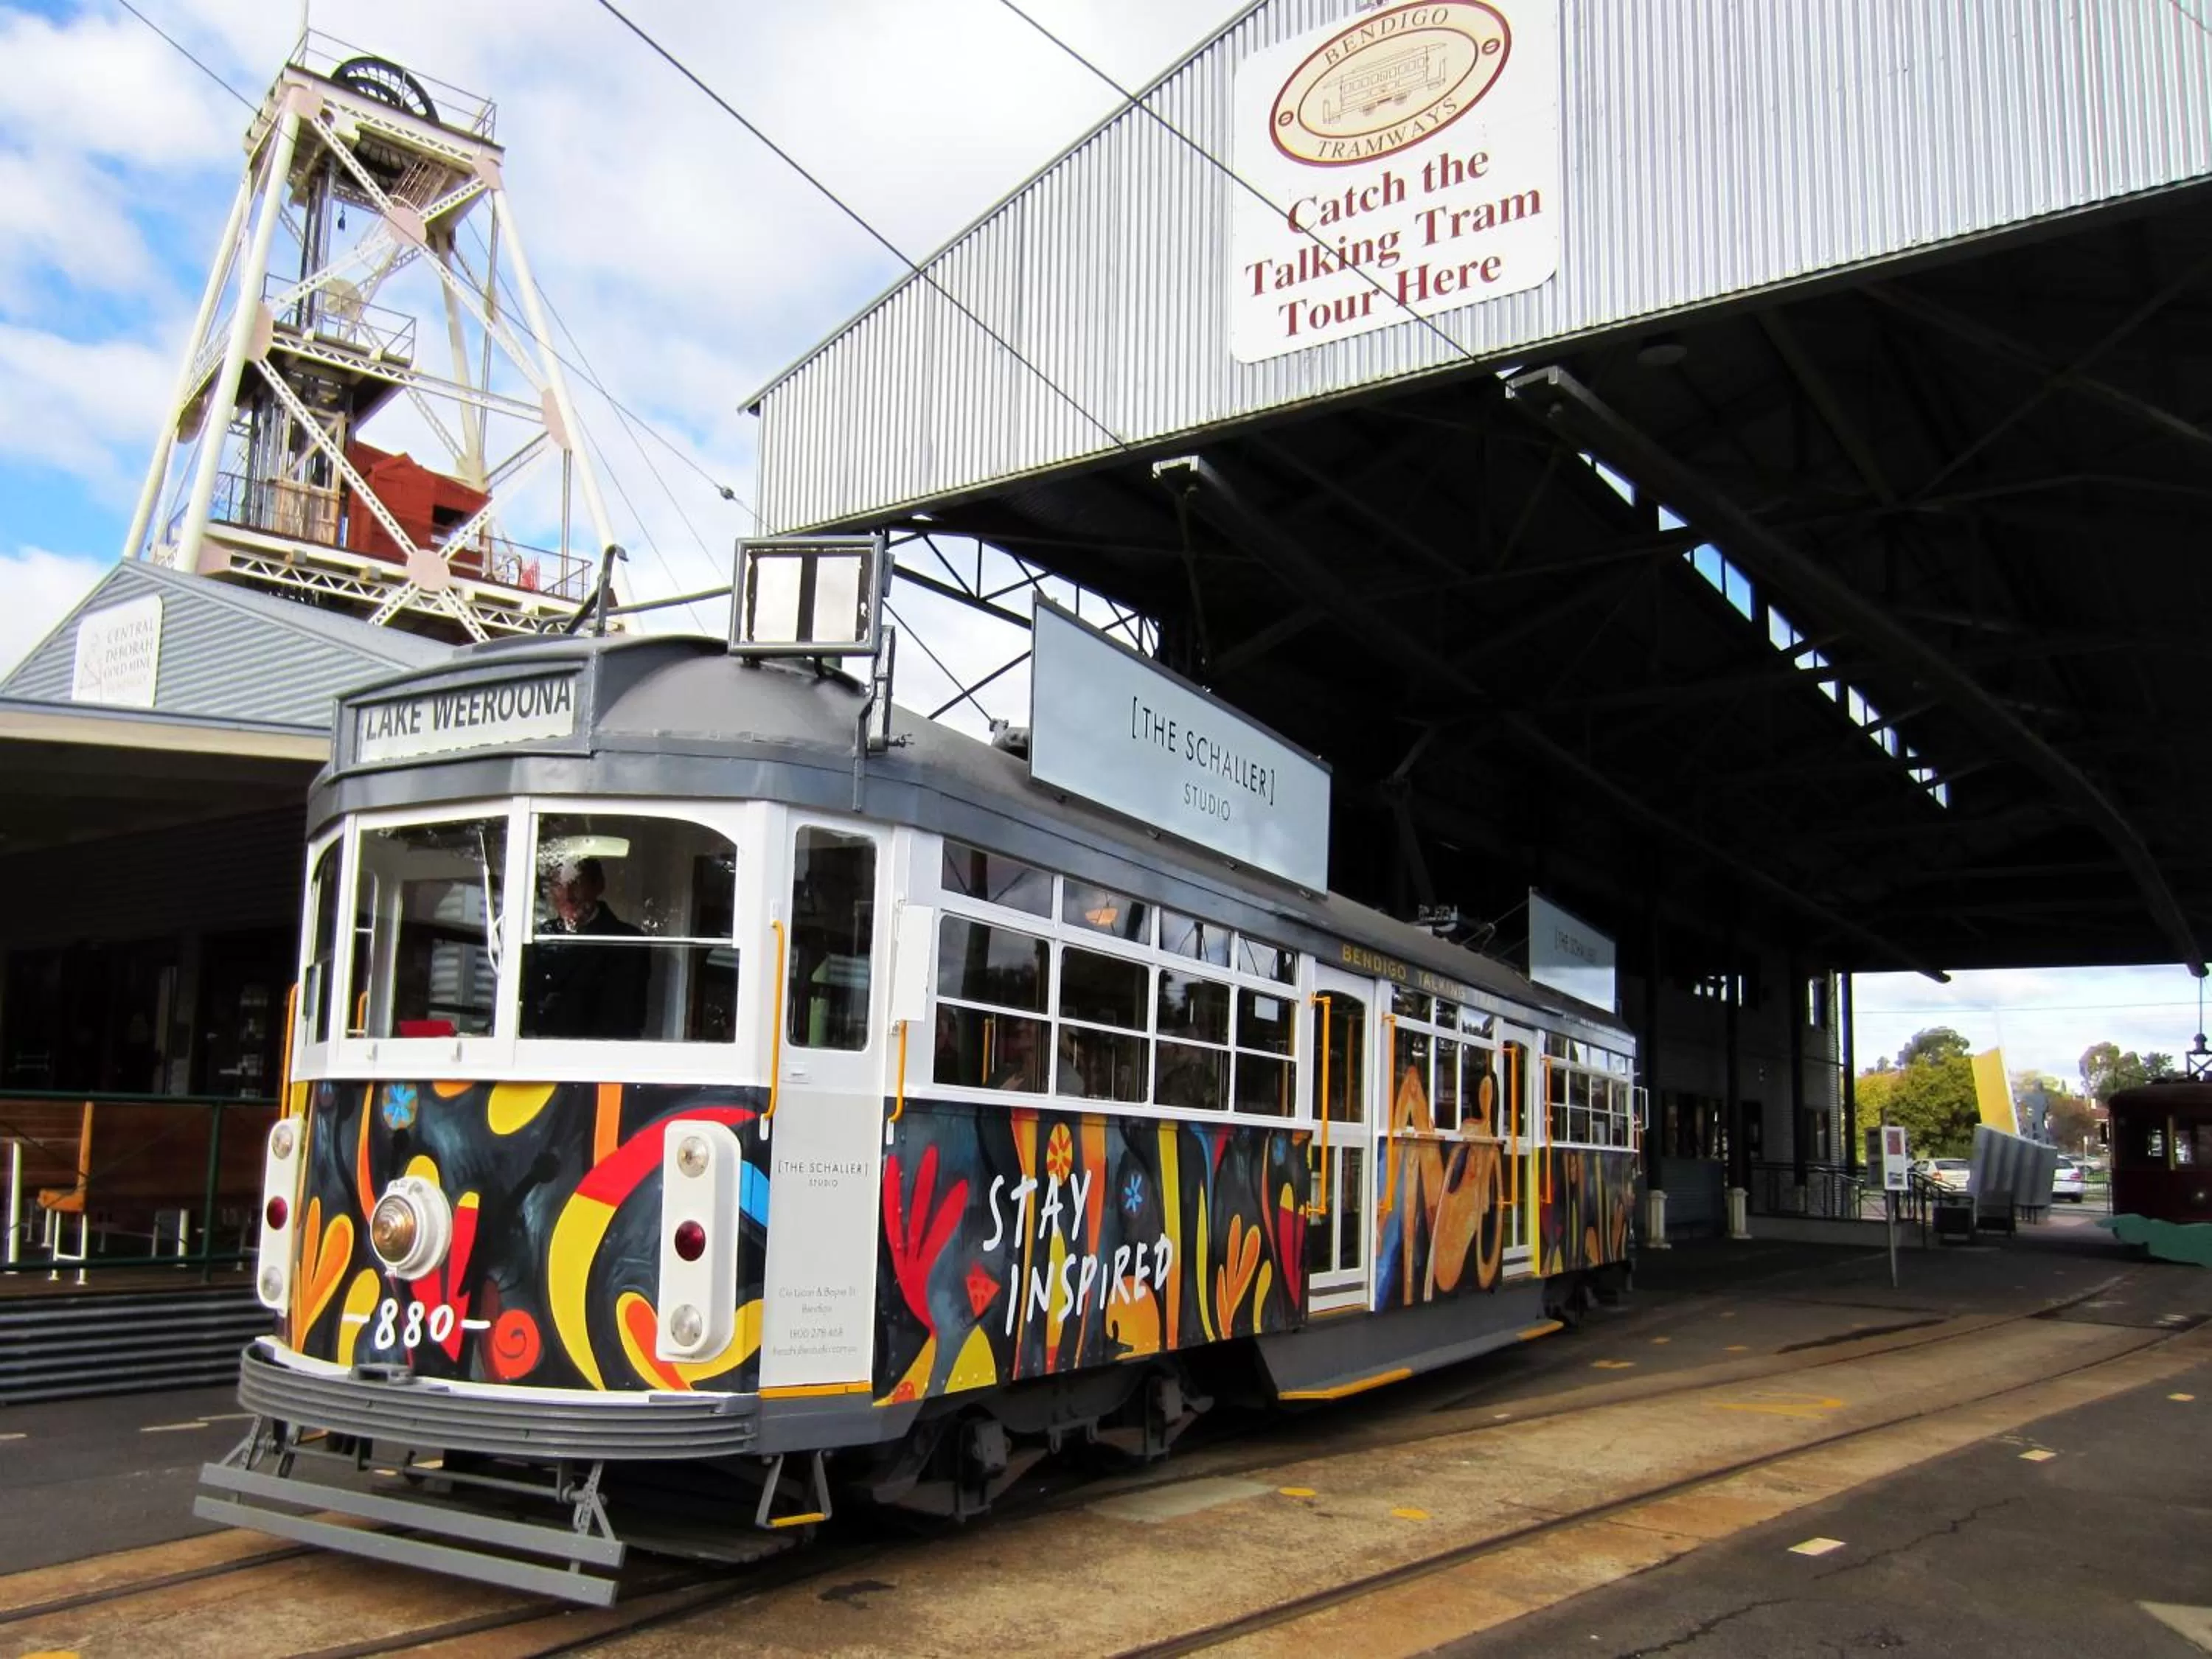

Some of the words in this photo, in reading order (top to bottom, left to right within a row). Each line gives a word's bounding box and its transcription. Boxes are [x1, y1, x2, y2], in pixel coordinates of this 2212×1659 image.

[1324, 7, 1450, 66] BENDIGO
[1317, 97, 1458, 159] TRAMWAYS
[1287, 170, 1407, 234] Catch
[1422, 151, 1489, 194] the
[1245, 230, 1401, 298] Talking
[1415, 188, 1543, 248] Tram
[1279, 288, 1380, 338] Tour
[1395, 254, 1503, 308] Here
[107, 617, 153, 644] CENTRAL
[366, 701, 422, 741] LAKE
[433, 678, 571, 731] WEEROONA
[1184, 782, 1231, 821] STUDIO
[1342, 943, 1407, 980] BENDIGO
[1416, 970, 1466, 999] TALKING
[809, 1179, 838, 1187] STUDIO
[983, 1169, 1091, 1251] STAY
[1005, 1232, 1173, 1337] INSPIRED
